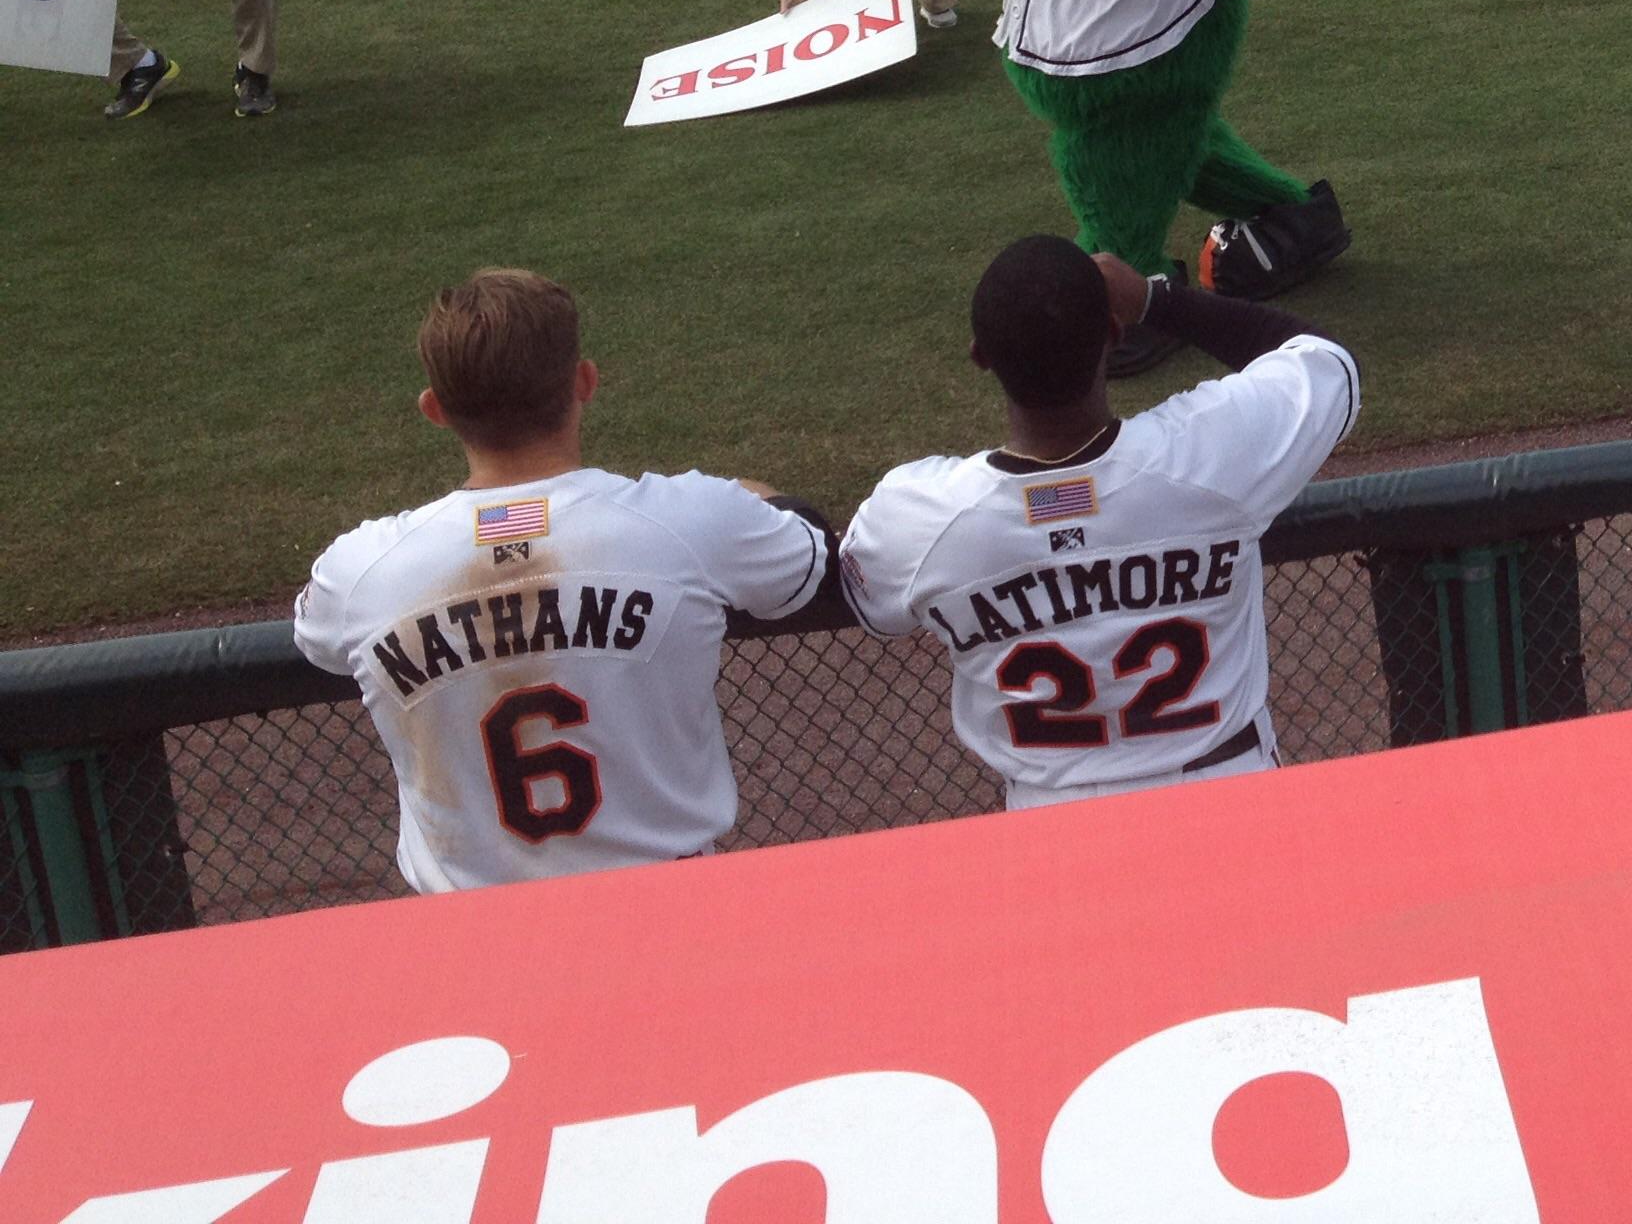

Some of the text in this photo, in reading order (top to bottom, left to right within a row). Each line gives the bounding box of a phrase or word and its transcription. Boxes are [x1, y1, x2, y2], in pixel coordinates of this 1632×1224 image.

[372, 586, 655, 698] NATHANS
[929, 540, 1240, 653] LATIMORE
[996, 616, 1221, 749] 22
[480, 682, 602, 845] 6
